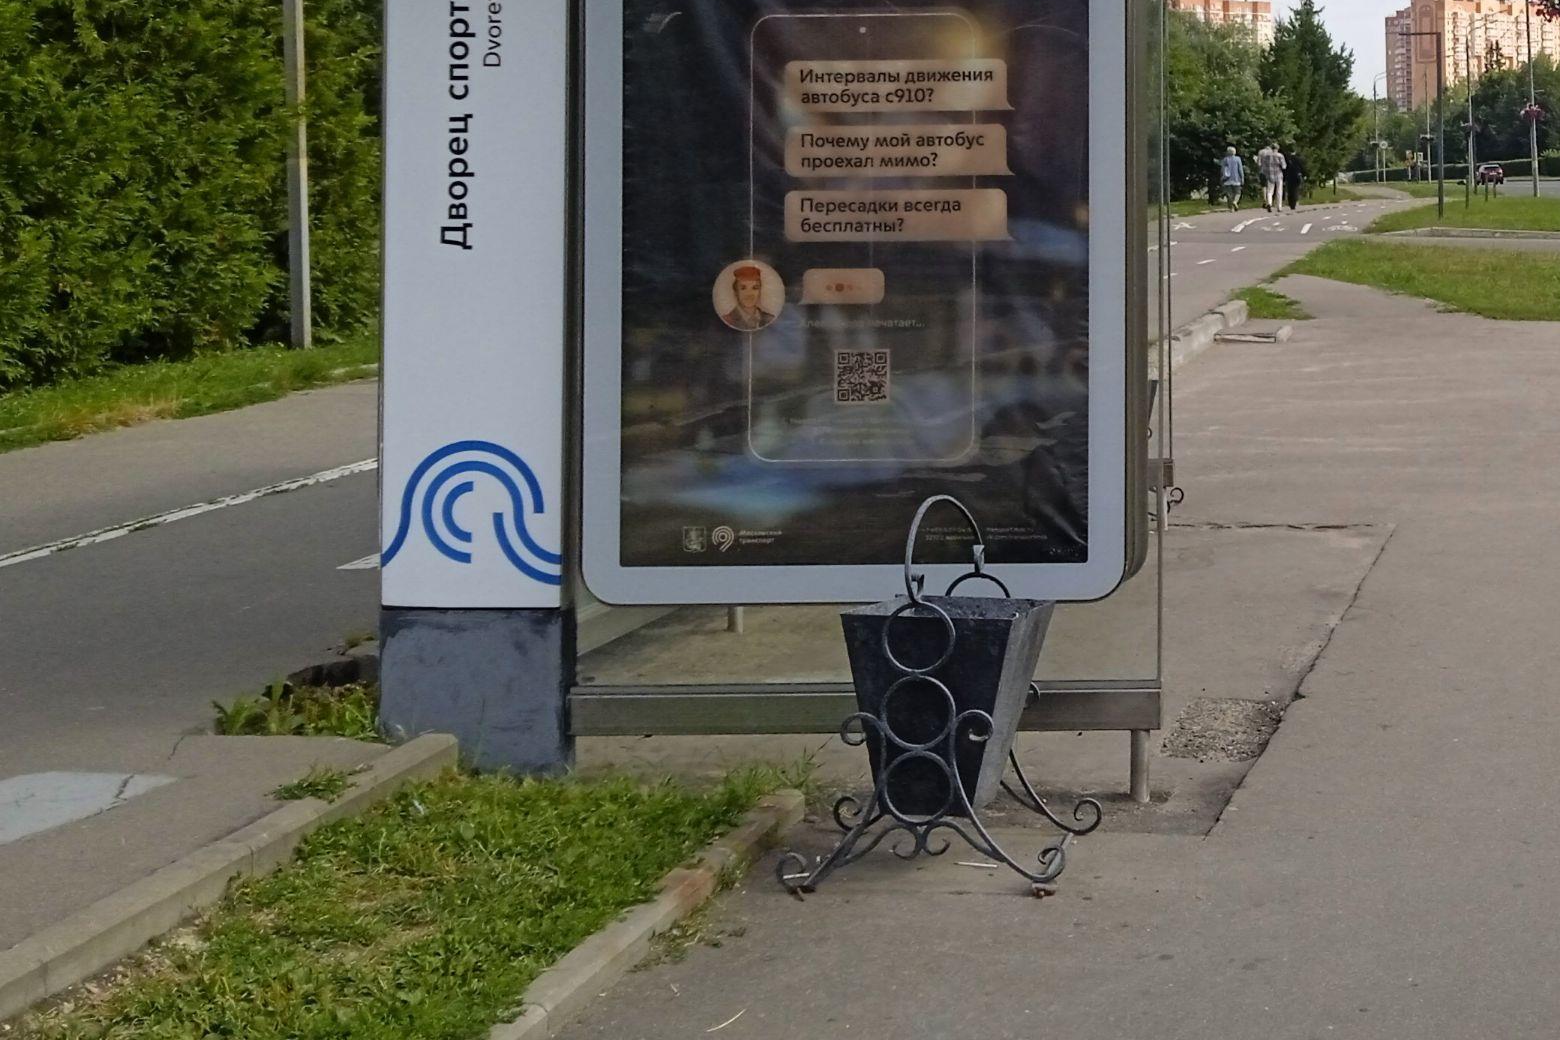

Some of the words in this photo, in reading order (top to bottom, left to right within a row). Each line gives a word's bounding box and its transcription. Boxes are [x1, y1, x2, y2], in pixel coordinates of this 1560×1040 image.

[800, 69, 900, 86] Интервалы
[904, 69, 994, 84] движения
[800, 90, 880, 106] автобуса
[885, 88, 934, 103] с910?
[800, 133, 869, 150] Почему
[874, 132, 911, 147] мой
[916, 131, 985, 149] автобус
[800, 155, 873, 171] проехал
[879, 153, 938, 168] мимо?
[440, 113, 475, 250] Дворец
[800, 198, 899, 215] Пересадки
[903, 199, 962, 213] всегда
[800, 217, 904, 233] бесплатны?
